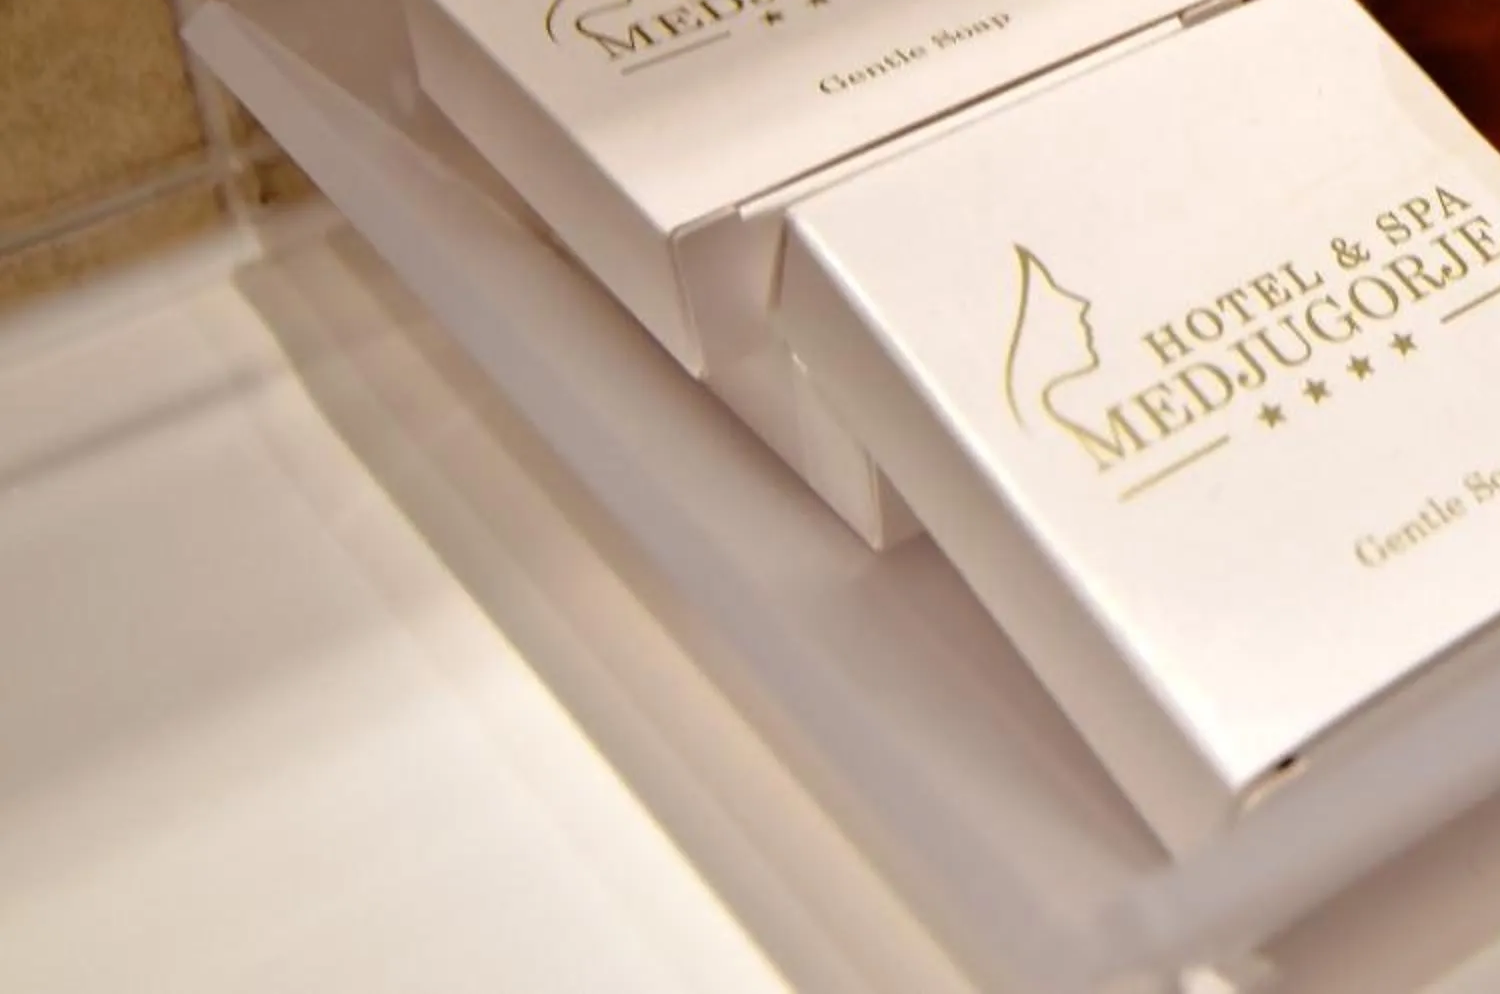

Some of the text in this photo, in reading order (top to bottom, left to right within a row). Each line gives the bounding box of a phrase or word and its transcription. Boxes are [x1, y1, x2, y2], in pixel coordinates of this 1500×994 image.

[817, 11, 1013, 97] Gentle Soap
[1141, 185, 1474, 367] HOTEL & SPA
[1352, 493, 1468, 570] Gentle
